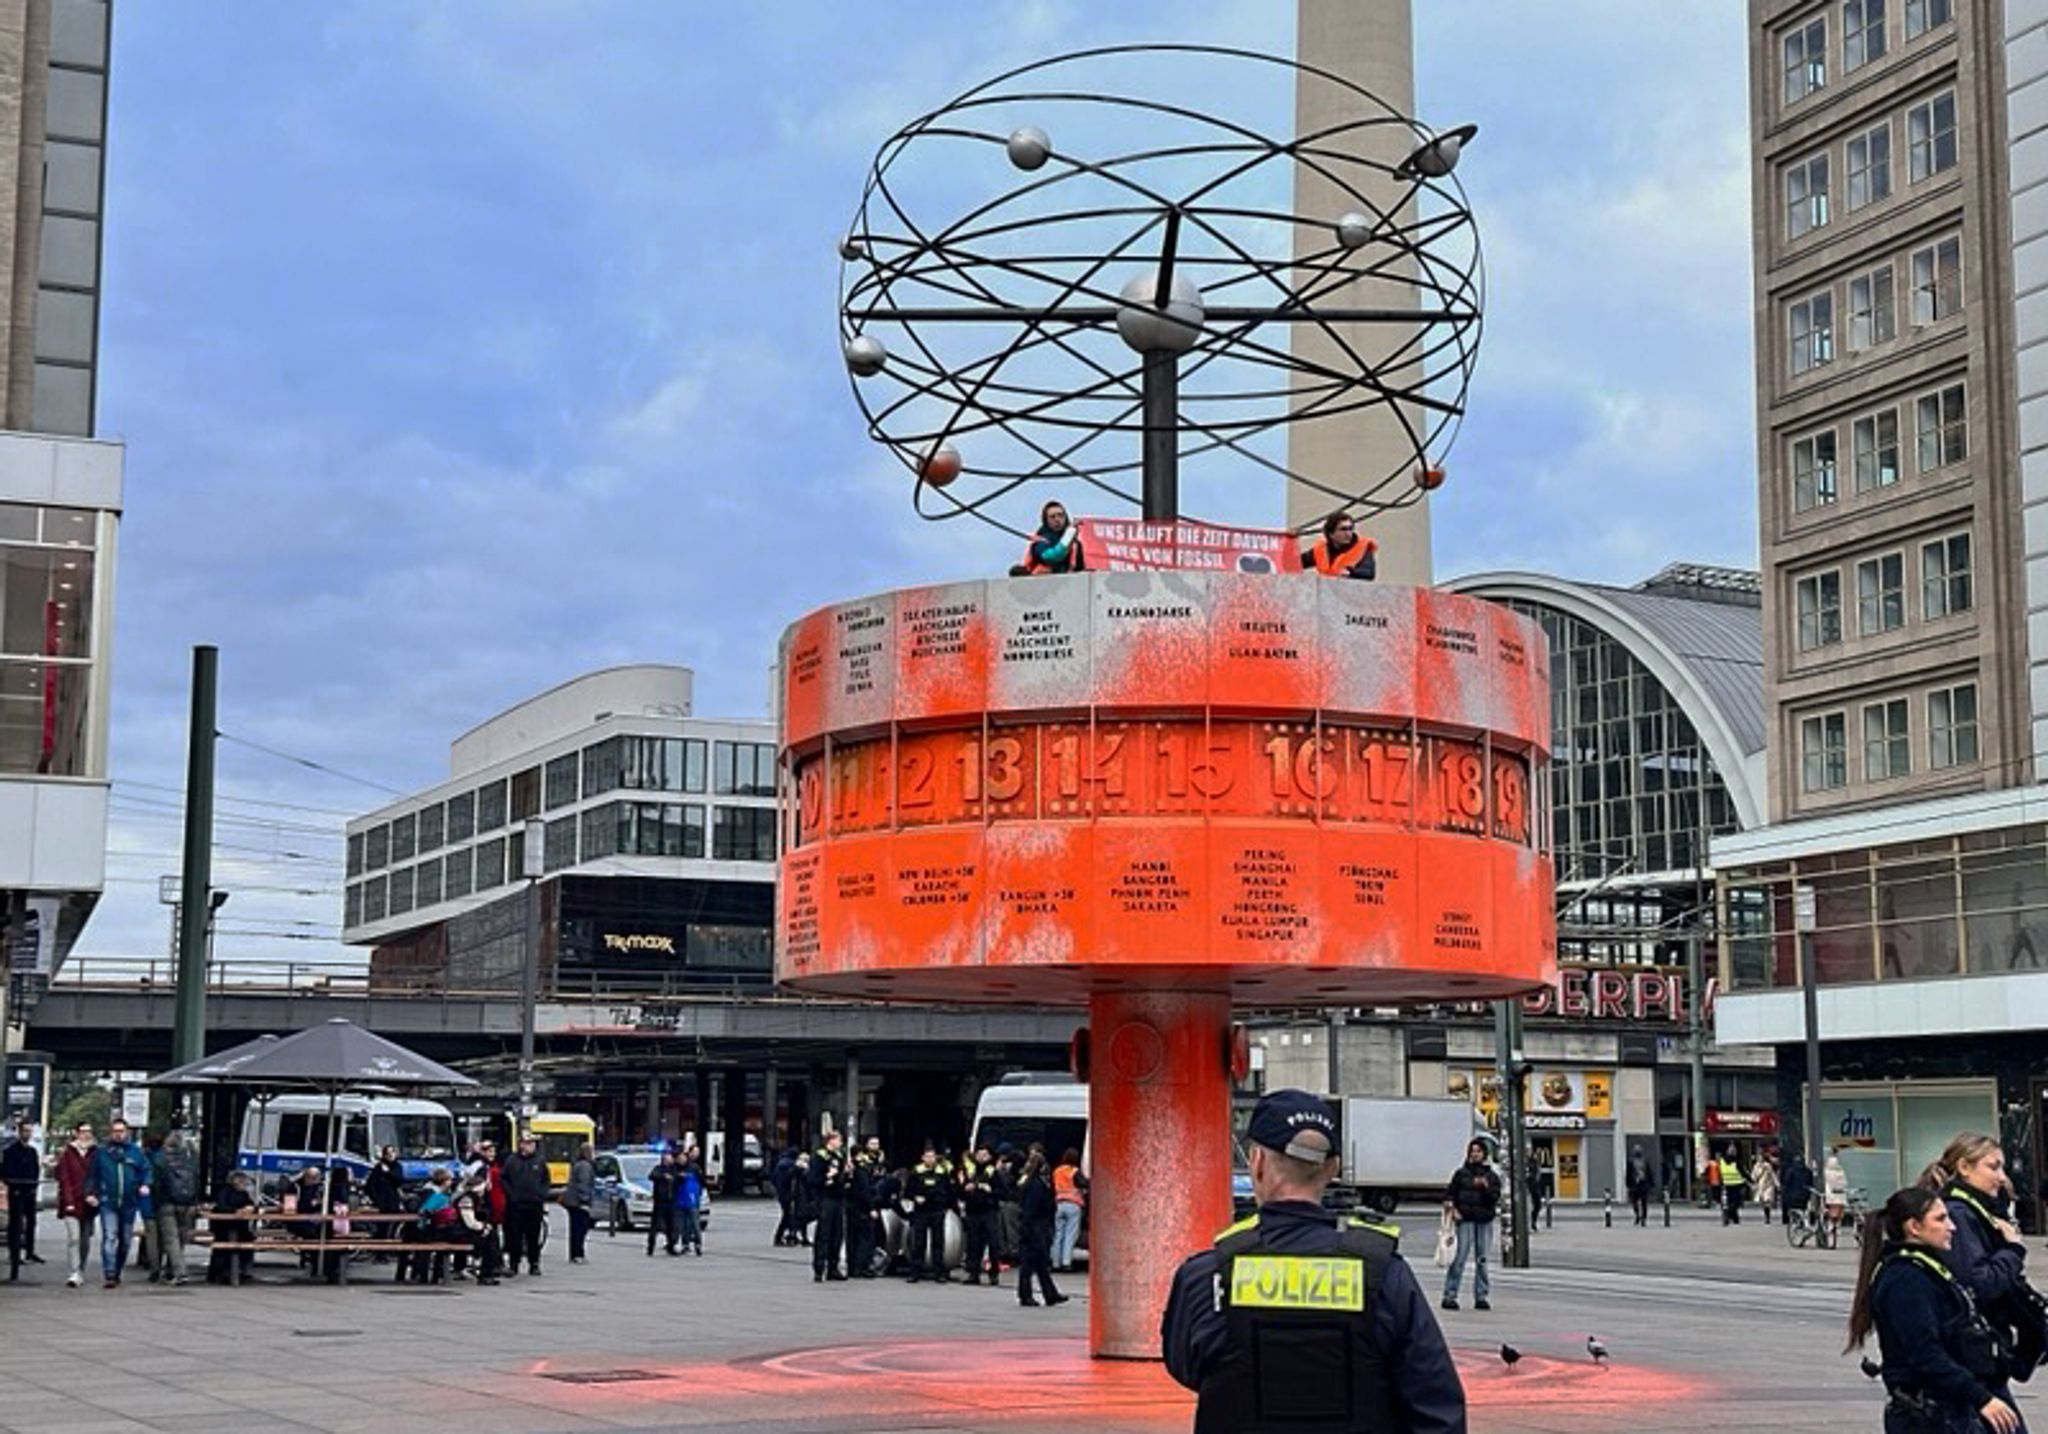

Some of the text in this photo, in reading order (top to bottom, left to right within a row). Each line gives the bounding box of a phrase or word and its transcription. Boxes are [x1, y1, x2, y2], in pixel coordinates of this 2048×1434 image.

[1129, 523, 1173, 542] LÄUFT
[1178, 527, 1199, 544] DIE
[1203, 528, 1230, 546] ZEIT
[1107, 543, 1138, 560] WEG
[1143, 546, 1173, 564] VON
[1178, 550, 1225, 567] FOSSIL
[1023, 610, 1053, 622] OMSK
[1108, 606, 1192, 618] KRASNOJARSK
[1017, 623, 1061, 636] ALMATY
[955, 736, 1025, 803] 13
[1051, 733, 1127, 798] 14
[1156, 736, 1235, 800] 15
[1263, 736, 1338, 802] 16
[1361, 742, 1421, 808] 17
[1439, 752, 1484, 818] 18
[1494, 763, 1522, 826] 19
[1244, 849, 1287, 861] PEKING
[1233, 862, 1297, 874] SHANGHAI
[1242, 875, 1288, 887] MANILA
[1247, 889, 1284, 900] PERTH
[1221, 914, 1260, 926] KUALA
[1287, 1112, 1335, 1130] POLIZEI
[1840, 1108, 1873, 1137] dm
[1236, 1259, 1359, 1305] POLIZEI
